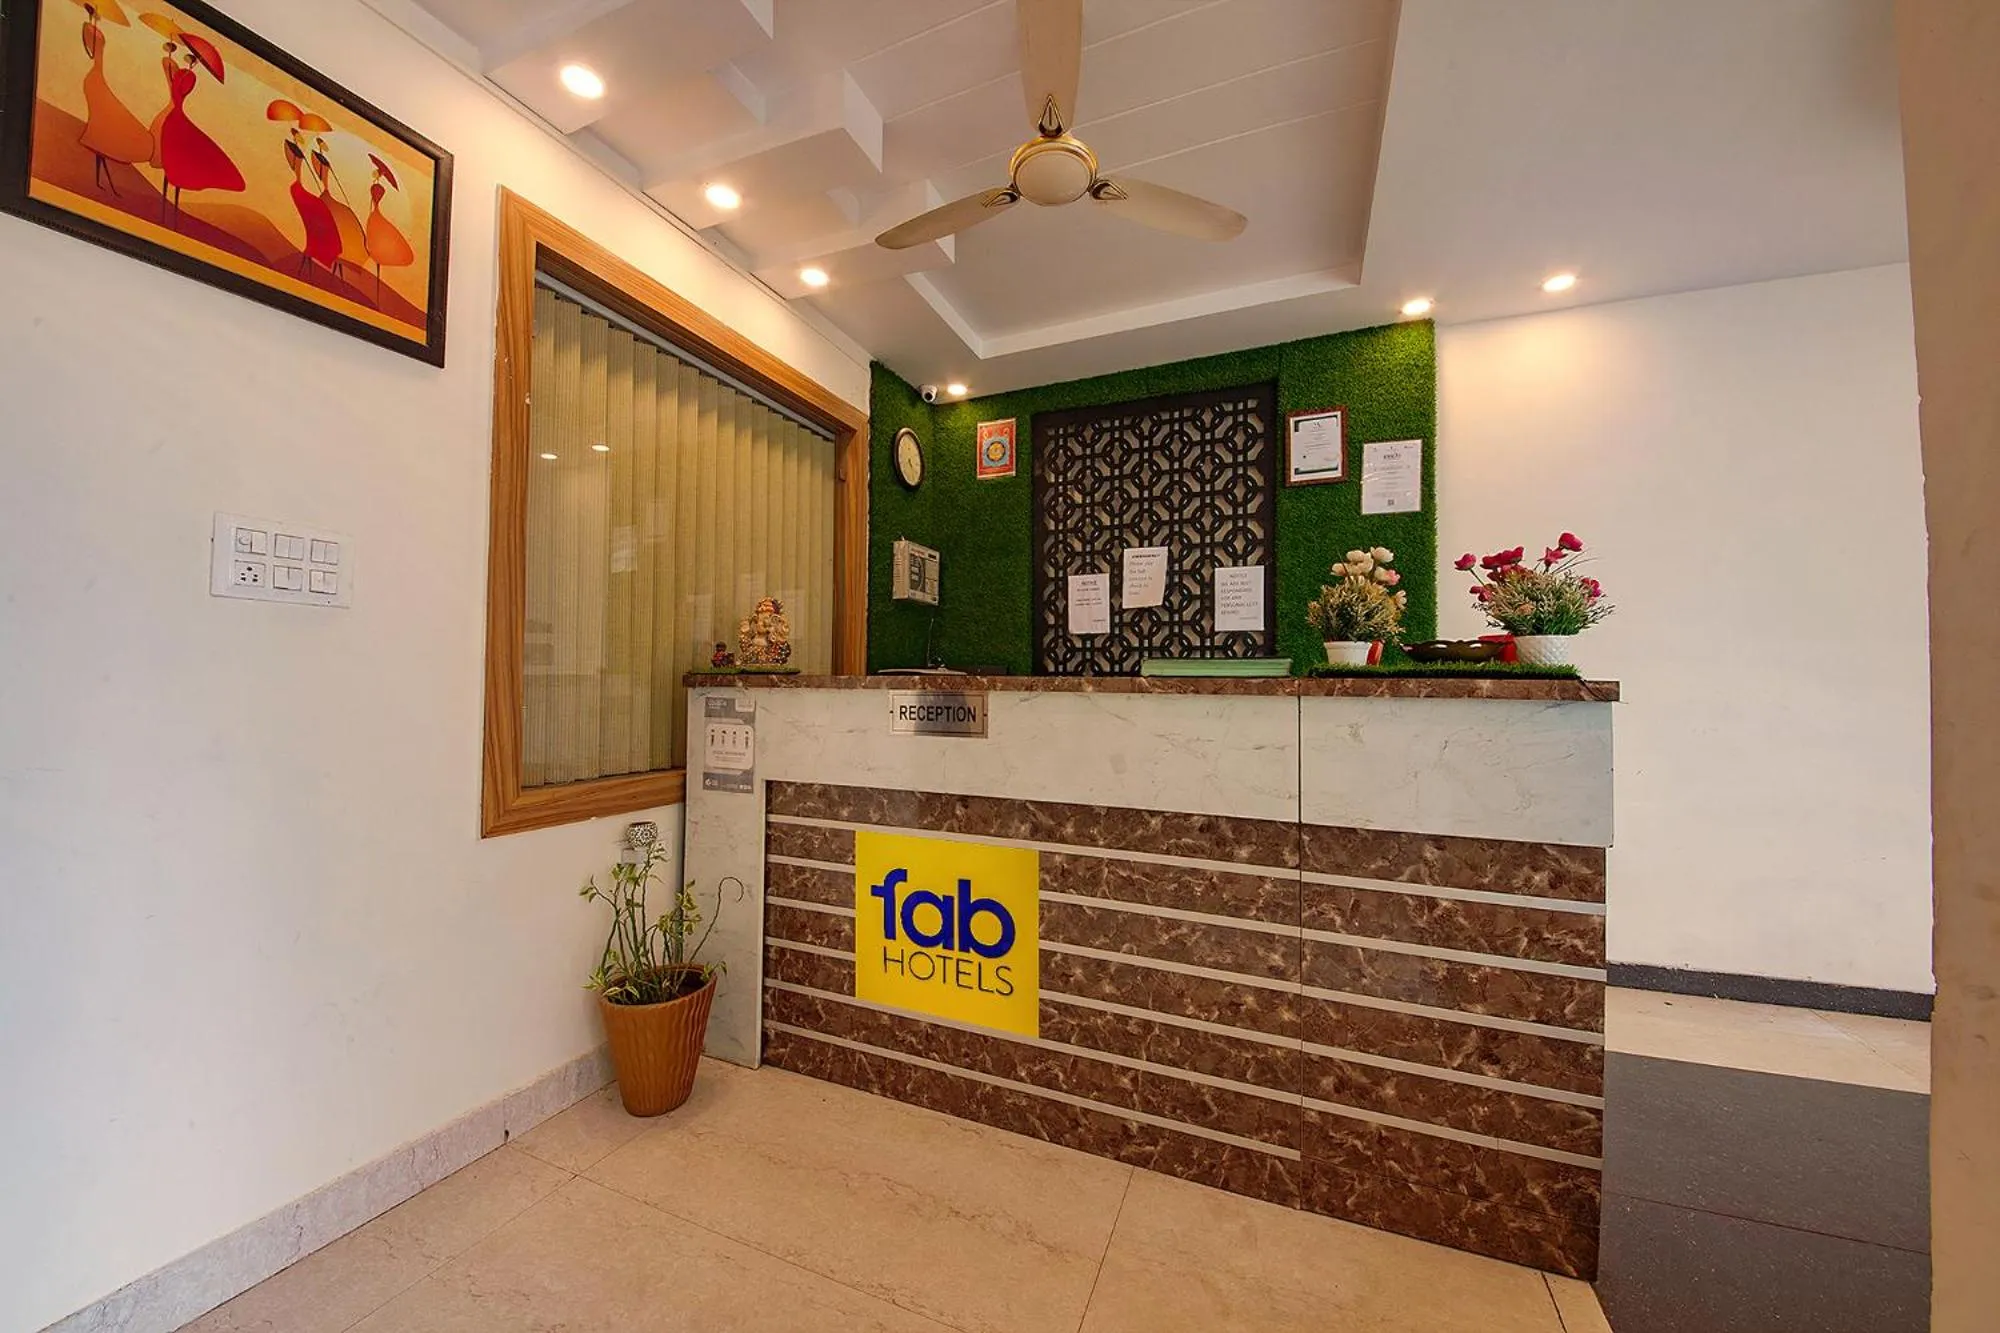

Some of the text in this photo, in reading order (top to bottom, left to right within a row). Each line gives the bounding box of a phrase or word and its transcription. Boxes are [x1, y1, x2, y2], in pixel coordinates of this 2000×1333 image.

[899, 704, 977, 723] RECEPTION
[870, 868, 1016, 959] fab
[883, 946, 1015, 997] HOTELS
